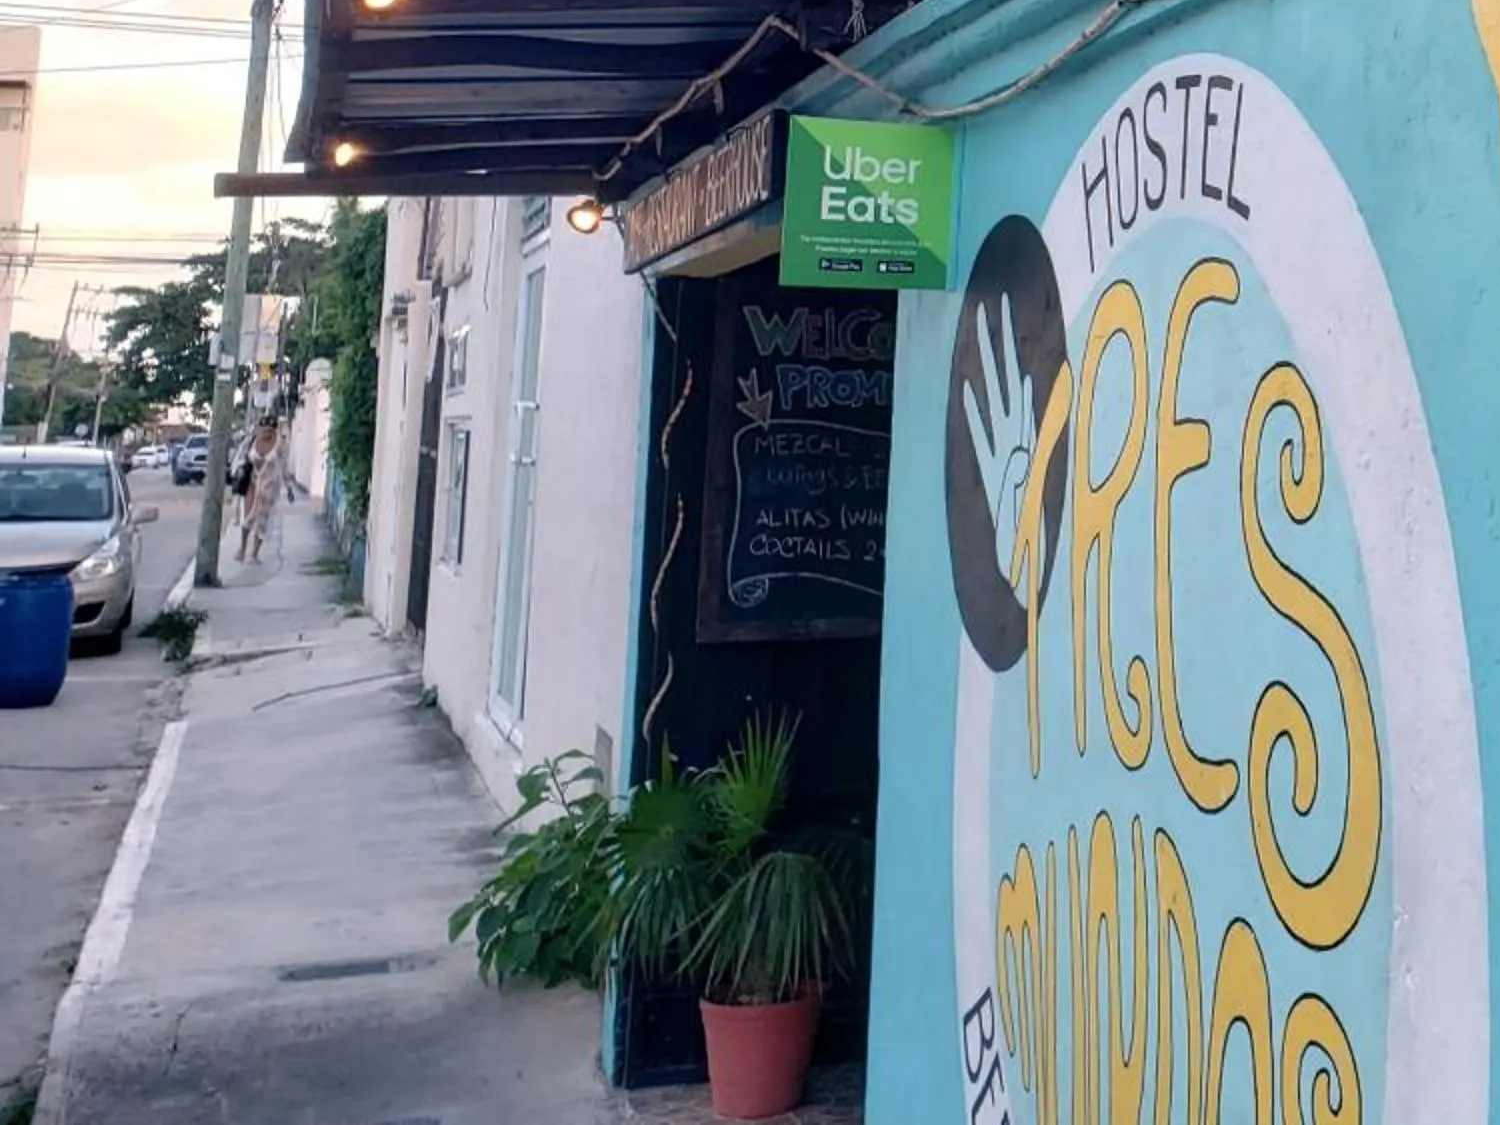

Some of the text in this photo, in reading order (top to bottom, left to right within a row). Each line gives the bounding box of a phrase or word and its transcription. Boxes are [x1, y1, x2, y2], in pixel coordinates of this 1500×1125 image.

[824, 144, 922, 185] Uber
[1081, 74, 1250, 272] HOSTEL
[821, 185, 919, 225] Eats
[755, 432, 851, 457] MEZCAL
[756, 508, 831, 529] ALITAS
[963, 986, 1010, 1125] BE
